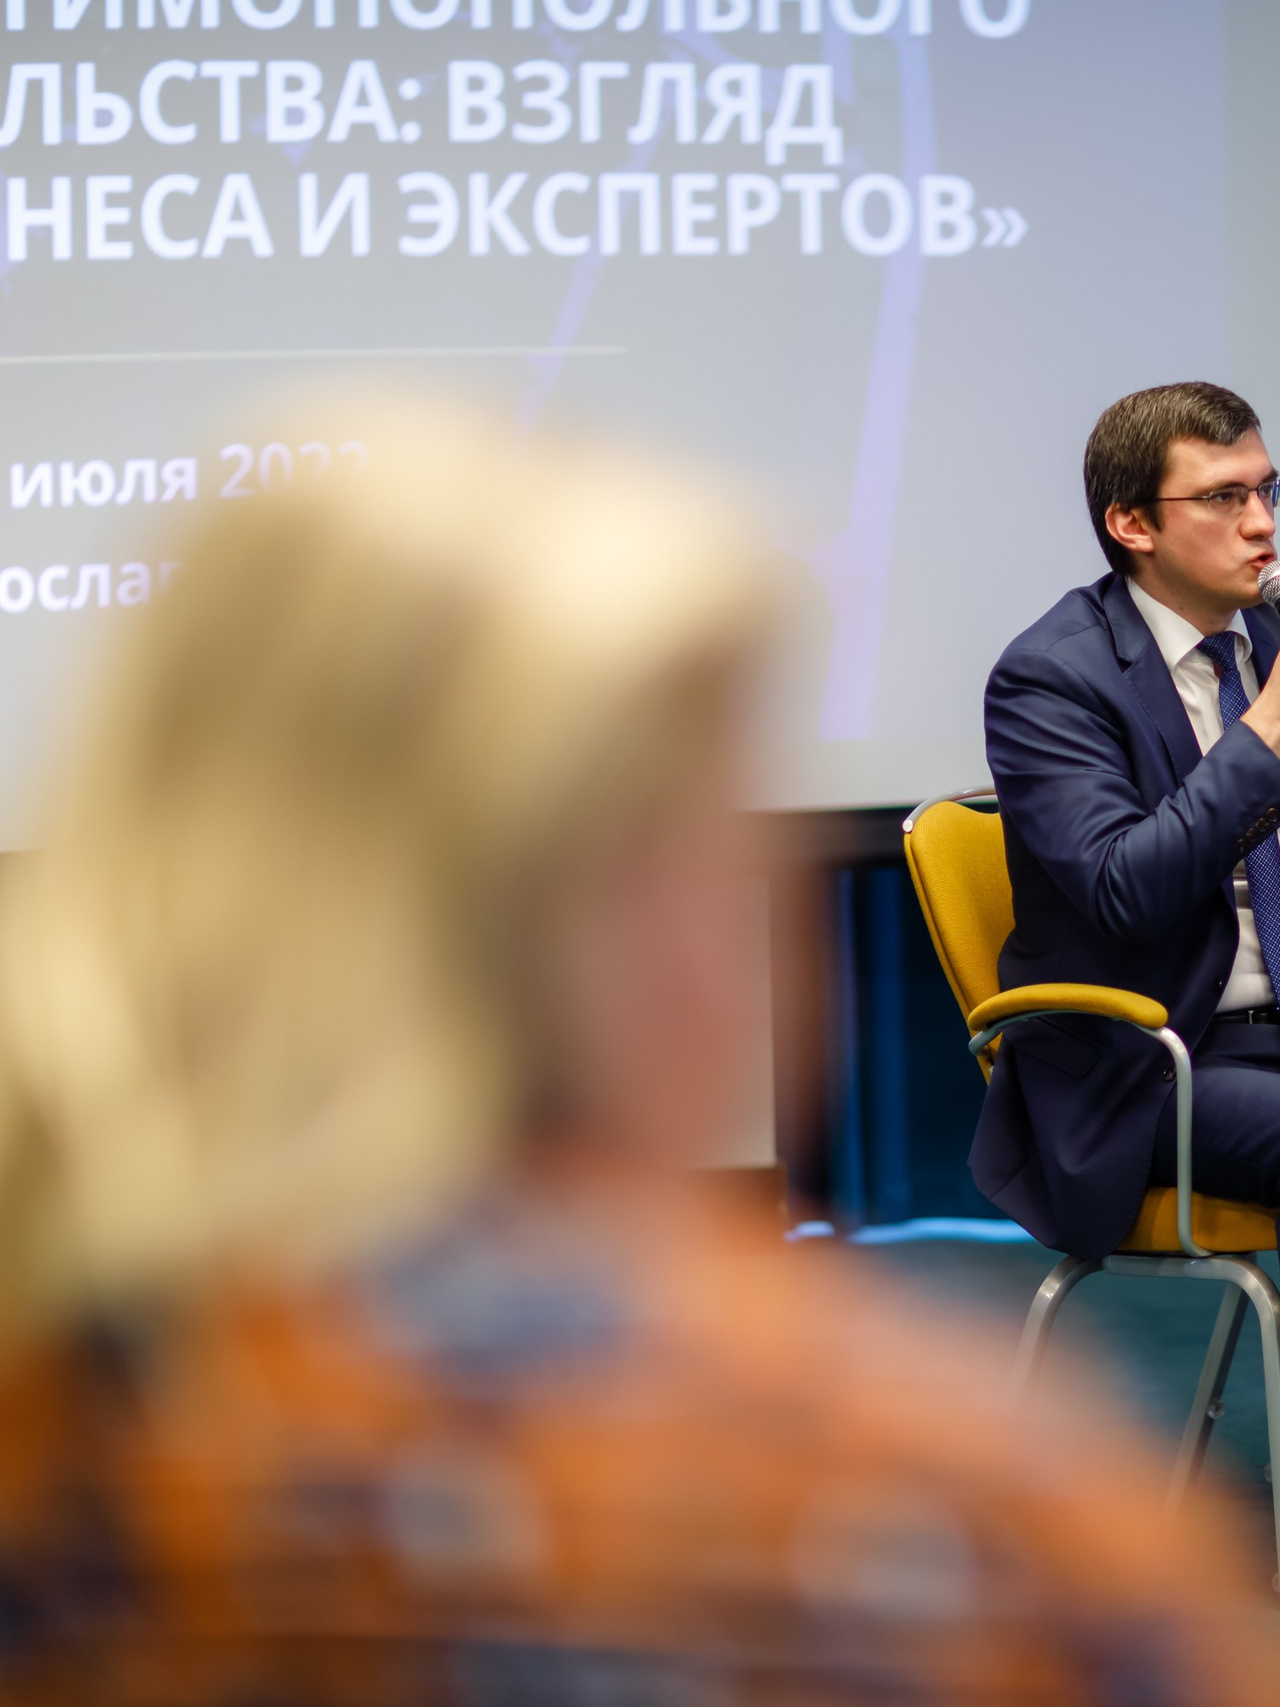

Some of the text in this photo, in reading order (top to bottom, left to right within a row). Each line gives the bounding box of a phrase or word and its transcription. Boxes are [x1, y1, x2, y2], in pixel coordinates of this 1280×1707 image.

[0, 59, 844, 166] ЛЬСТВА: ВЗГЛЯД
[5, 171, 1030, 261] НЕСА И ЭКСПЕРТОВ»
[9, 456, 197, 509] июля
[0, 560, 186, 613] осла
